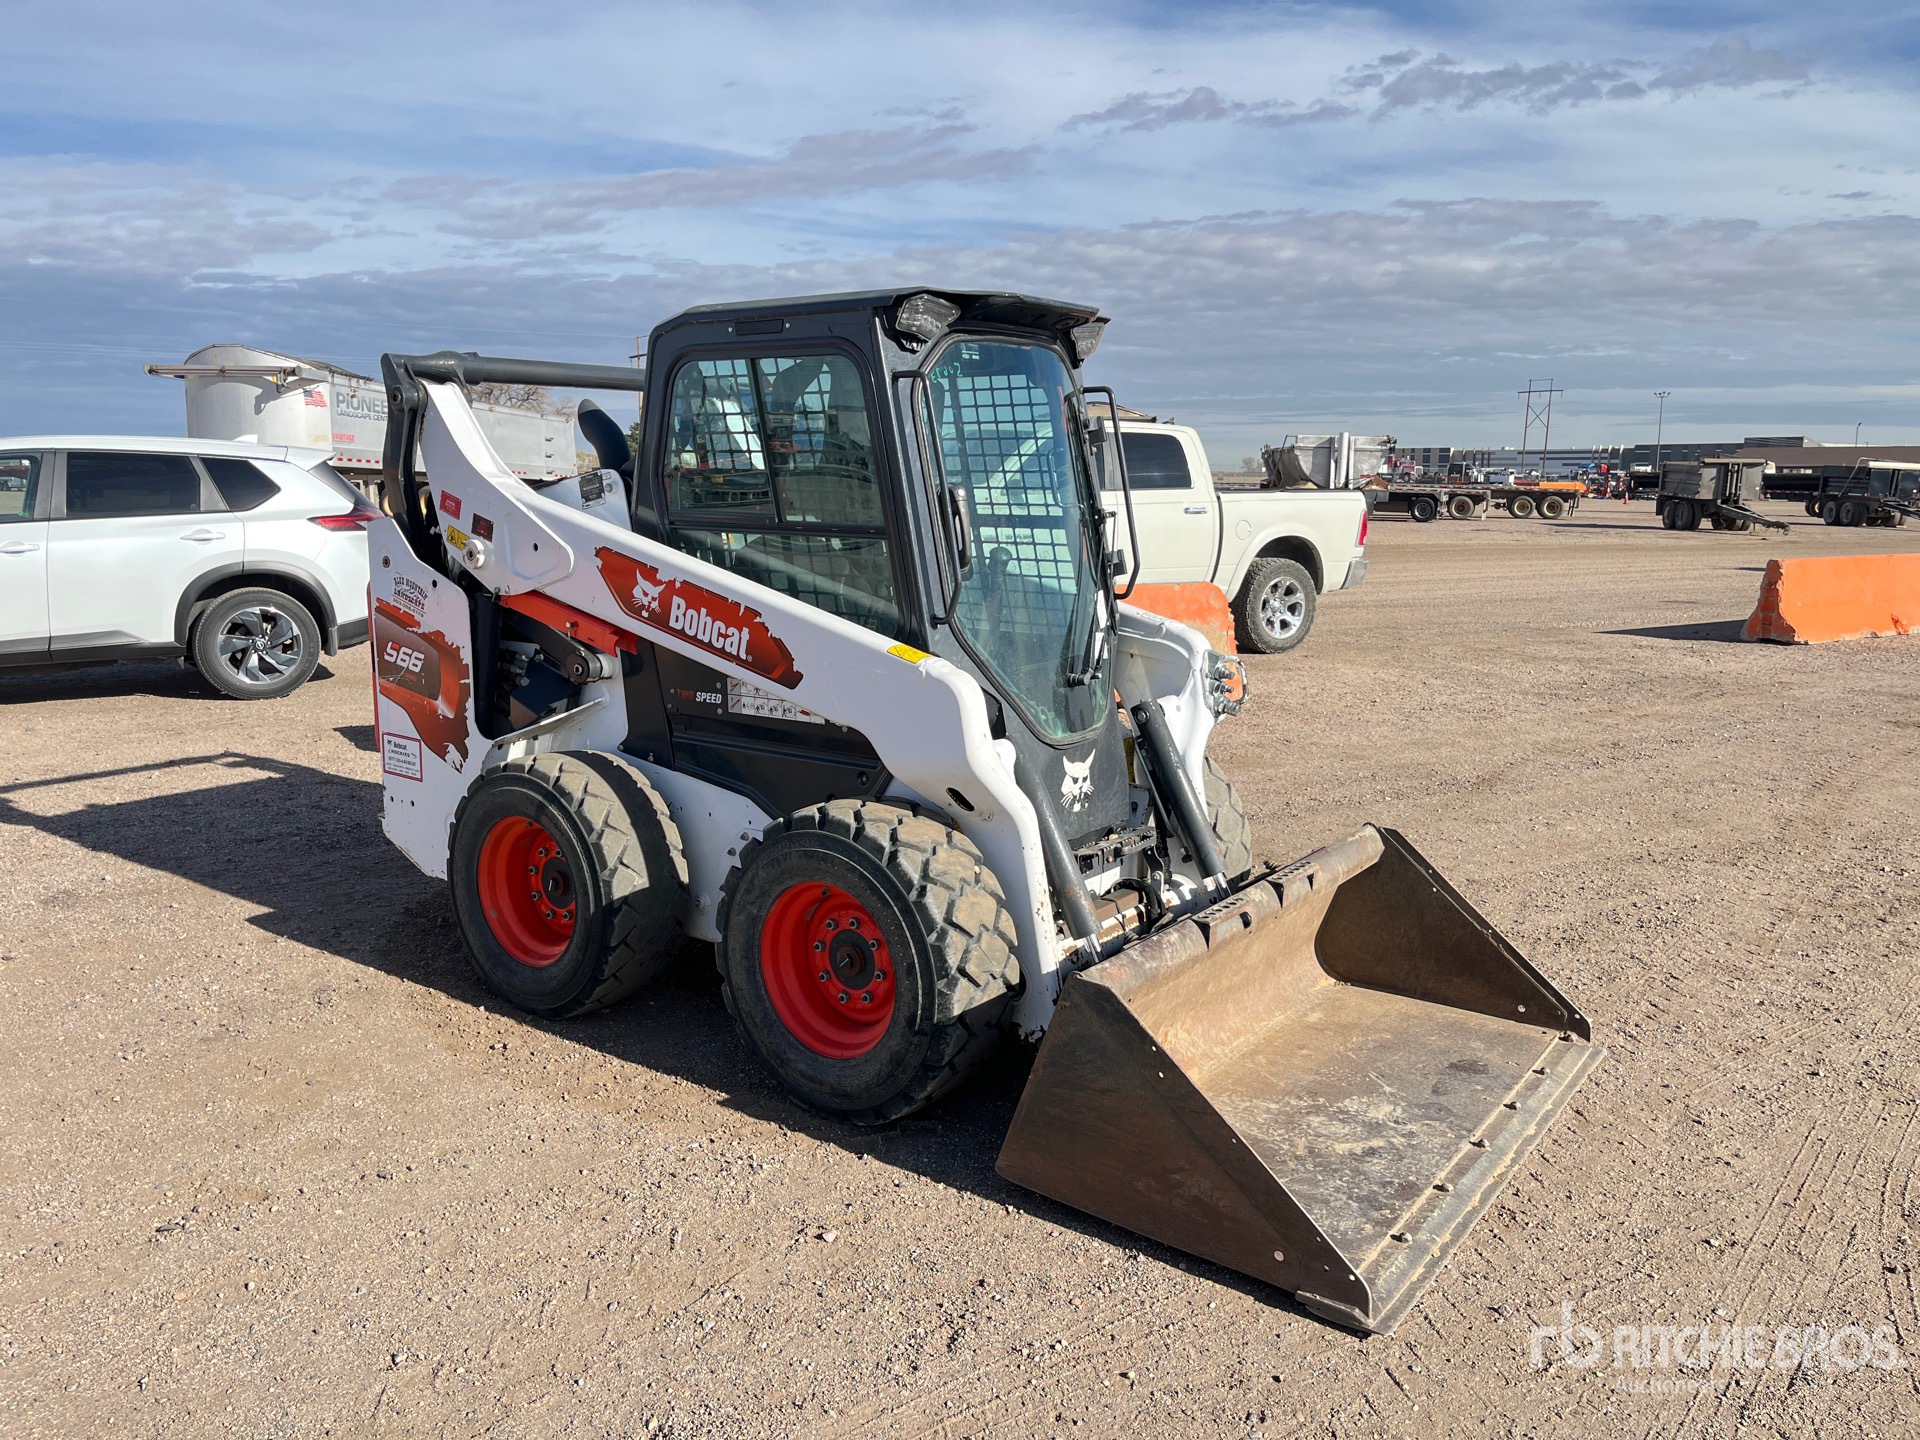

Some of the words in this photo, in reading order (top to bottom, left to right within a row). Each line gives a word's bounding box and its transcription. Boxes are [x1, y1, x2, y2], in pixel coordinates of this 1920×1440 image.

[337, 409, 372, 421] LANDSCAPE
[373, 413, 388, 422] CENT
[393, 587, 425, 610] LANDSCAPE
[669, 595, 750, 661] Bobcat
[383, 641, 425, 673] S66
[677, 689, 694, 700] TWO
[695, 691, 722, 704] SPEED
